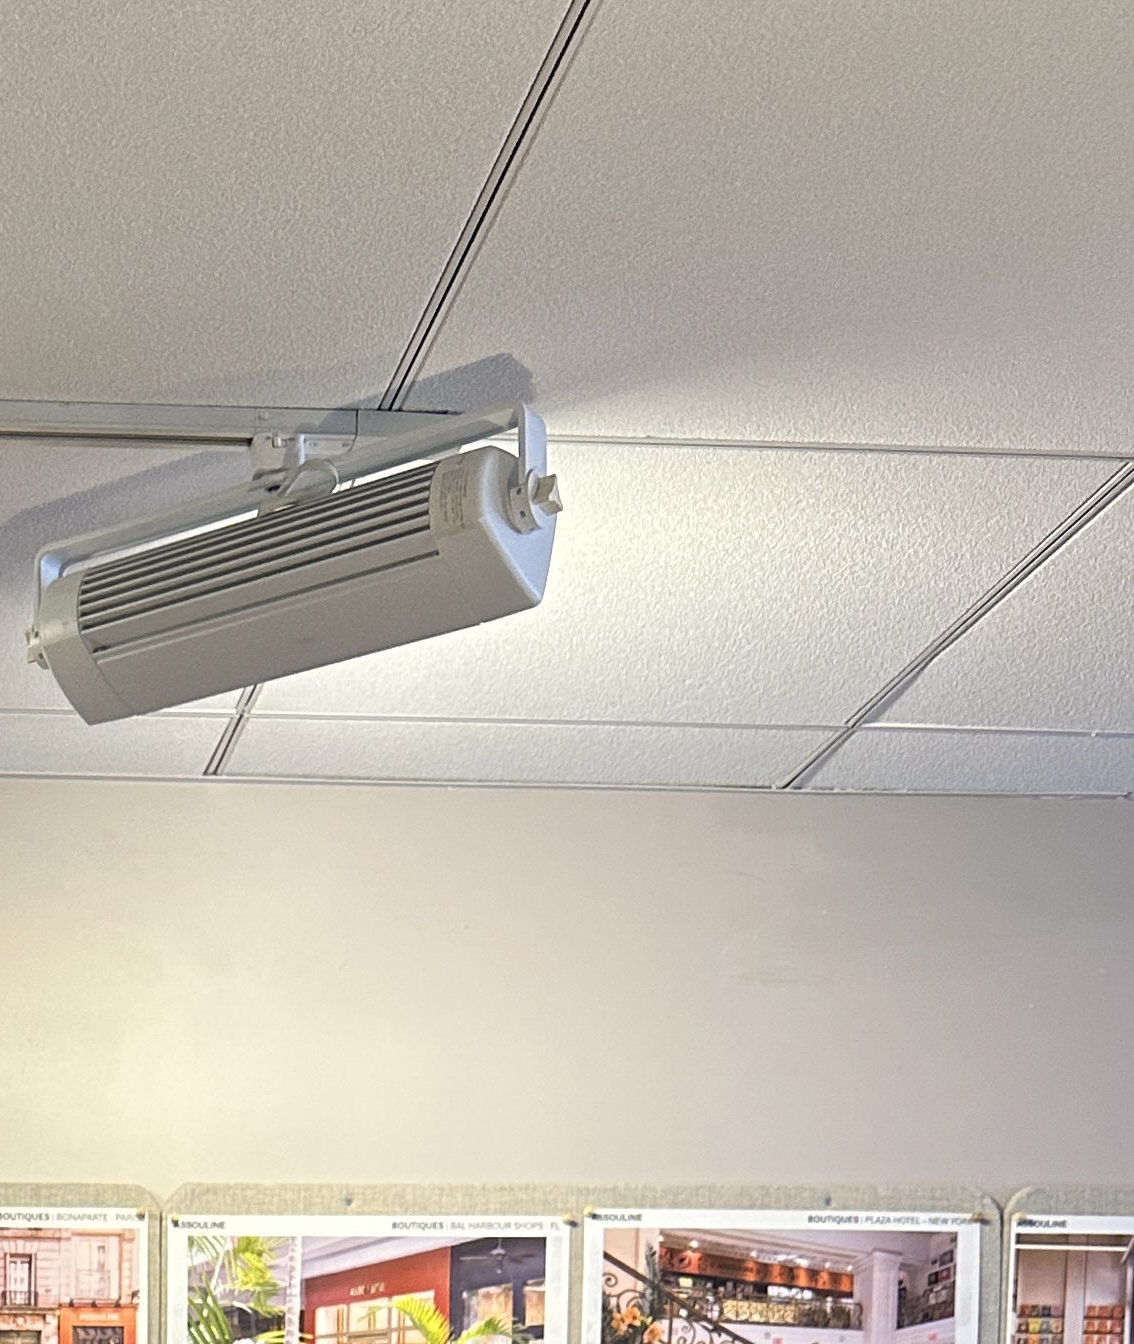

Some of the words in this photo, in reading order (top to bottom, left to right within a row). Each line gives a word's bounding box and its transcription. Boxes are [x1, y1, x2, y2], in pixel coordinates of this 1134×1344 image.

[56, 1212, 108, 1222] BONAPARTE
[591, 1213, 643, 1222] SSOULINE
[807, 1215, 860, 1226] BOUTIQUES
[865, 1216, 892, 1226] PLAZA
[928, 1217, 949, 1226] NEW
[172, 1220, 225, 1230] SSOULINE
[391, 1221, 443, 1231] BOUTIQUES
[450, 1221, 466, 1231] BAL
[468, 1221, 512, 1231] HARBOUR
[513, 1222, 544, 1231] SHOPS
